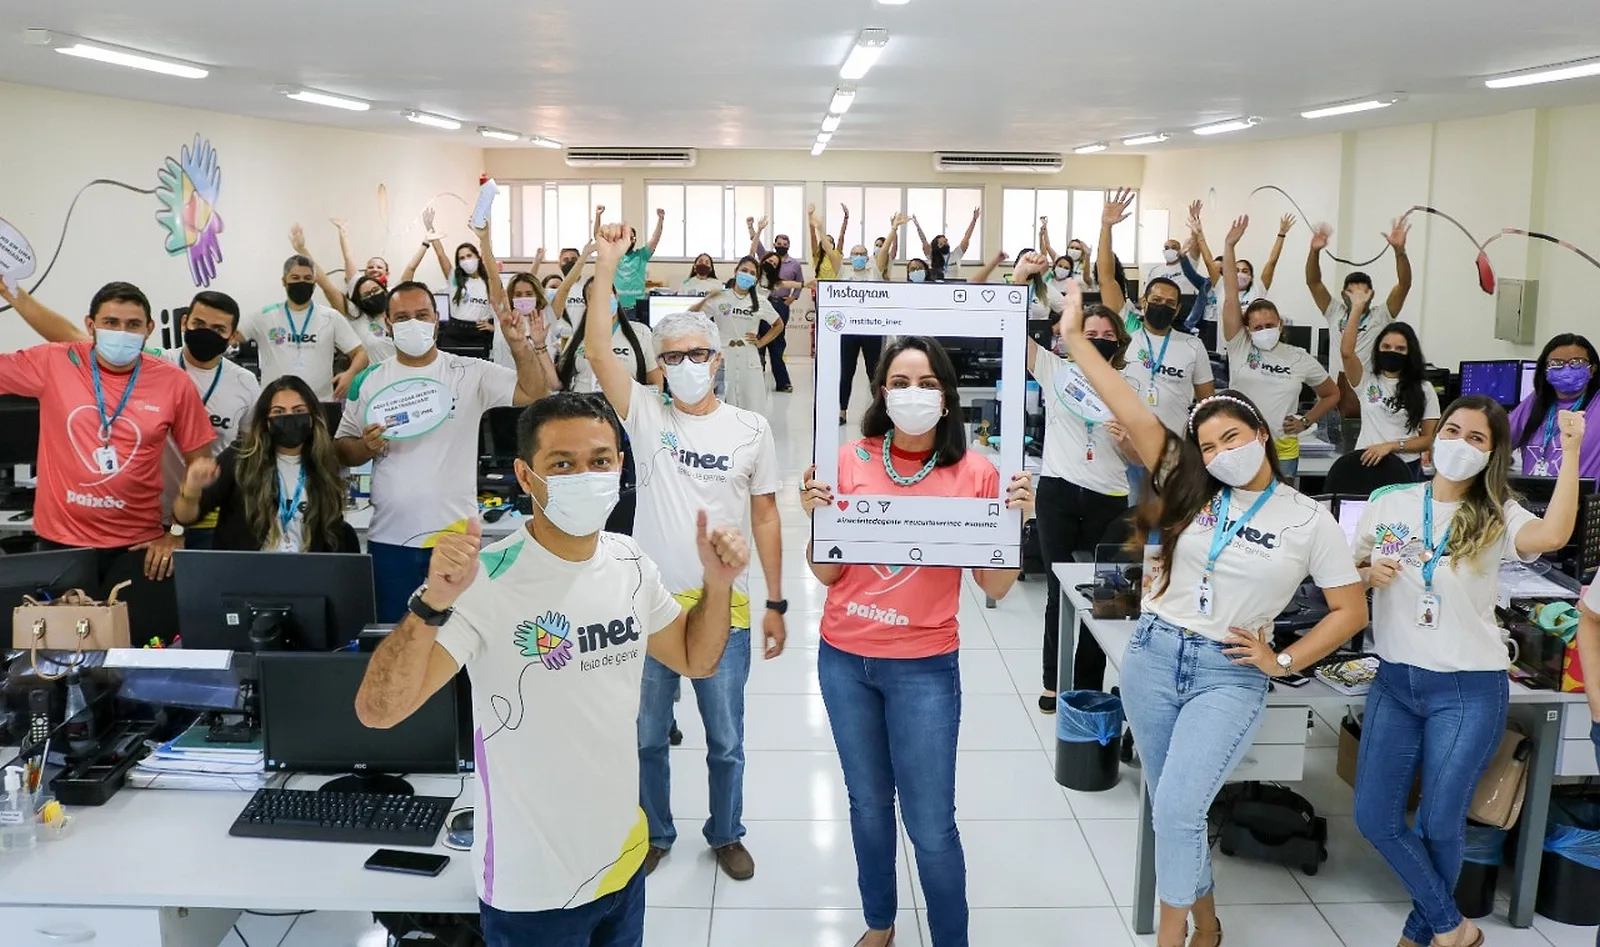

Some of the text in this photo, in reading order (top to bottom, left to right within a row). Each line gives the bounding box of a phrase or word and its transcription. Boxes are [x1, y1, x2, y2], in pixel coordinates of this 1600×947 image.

[827, 284, 890, 304] Instagram
[849, 316, 903, 327] instituto_inec
[1261, 363, 1291, 375] inec
[679, 449, 729, 471] inec
[66, 489, 126, 508] paixão
[846, 600, 910, 626] paixão
[577, 616, 639, 653] inec
[602, 653, 613, 666] de
